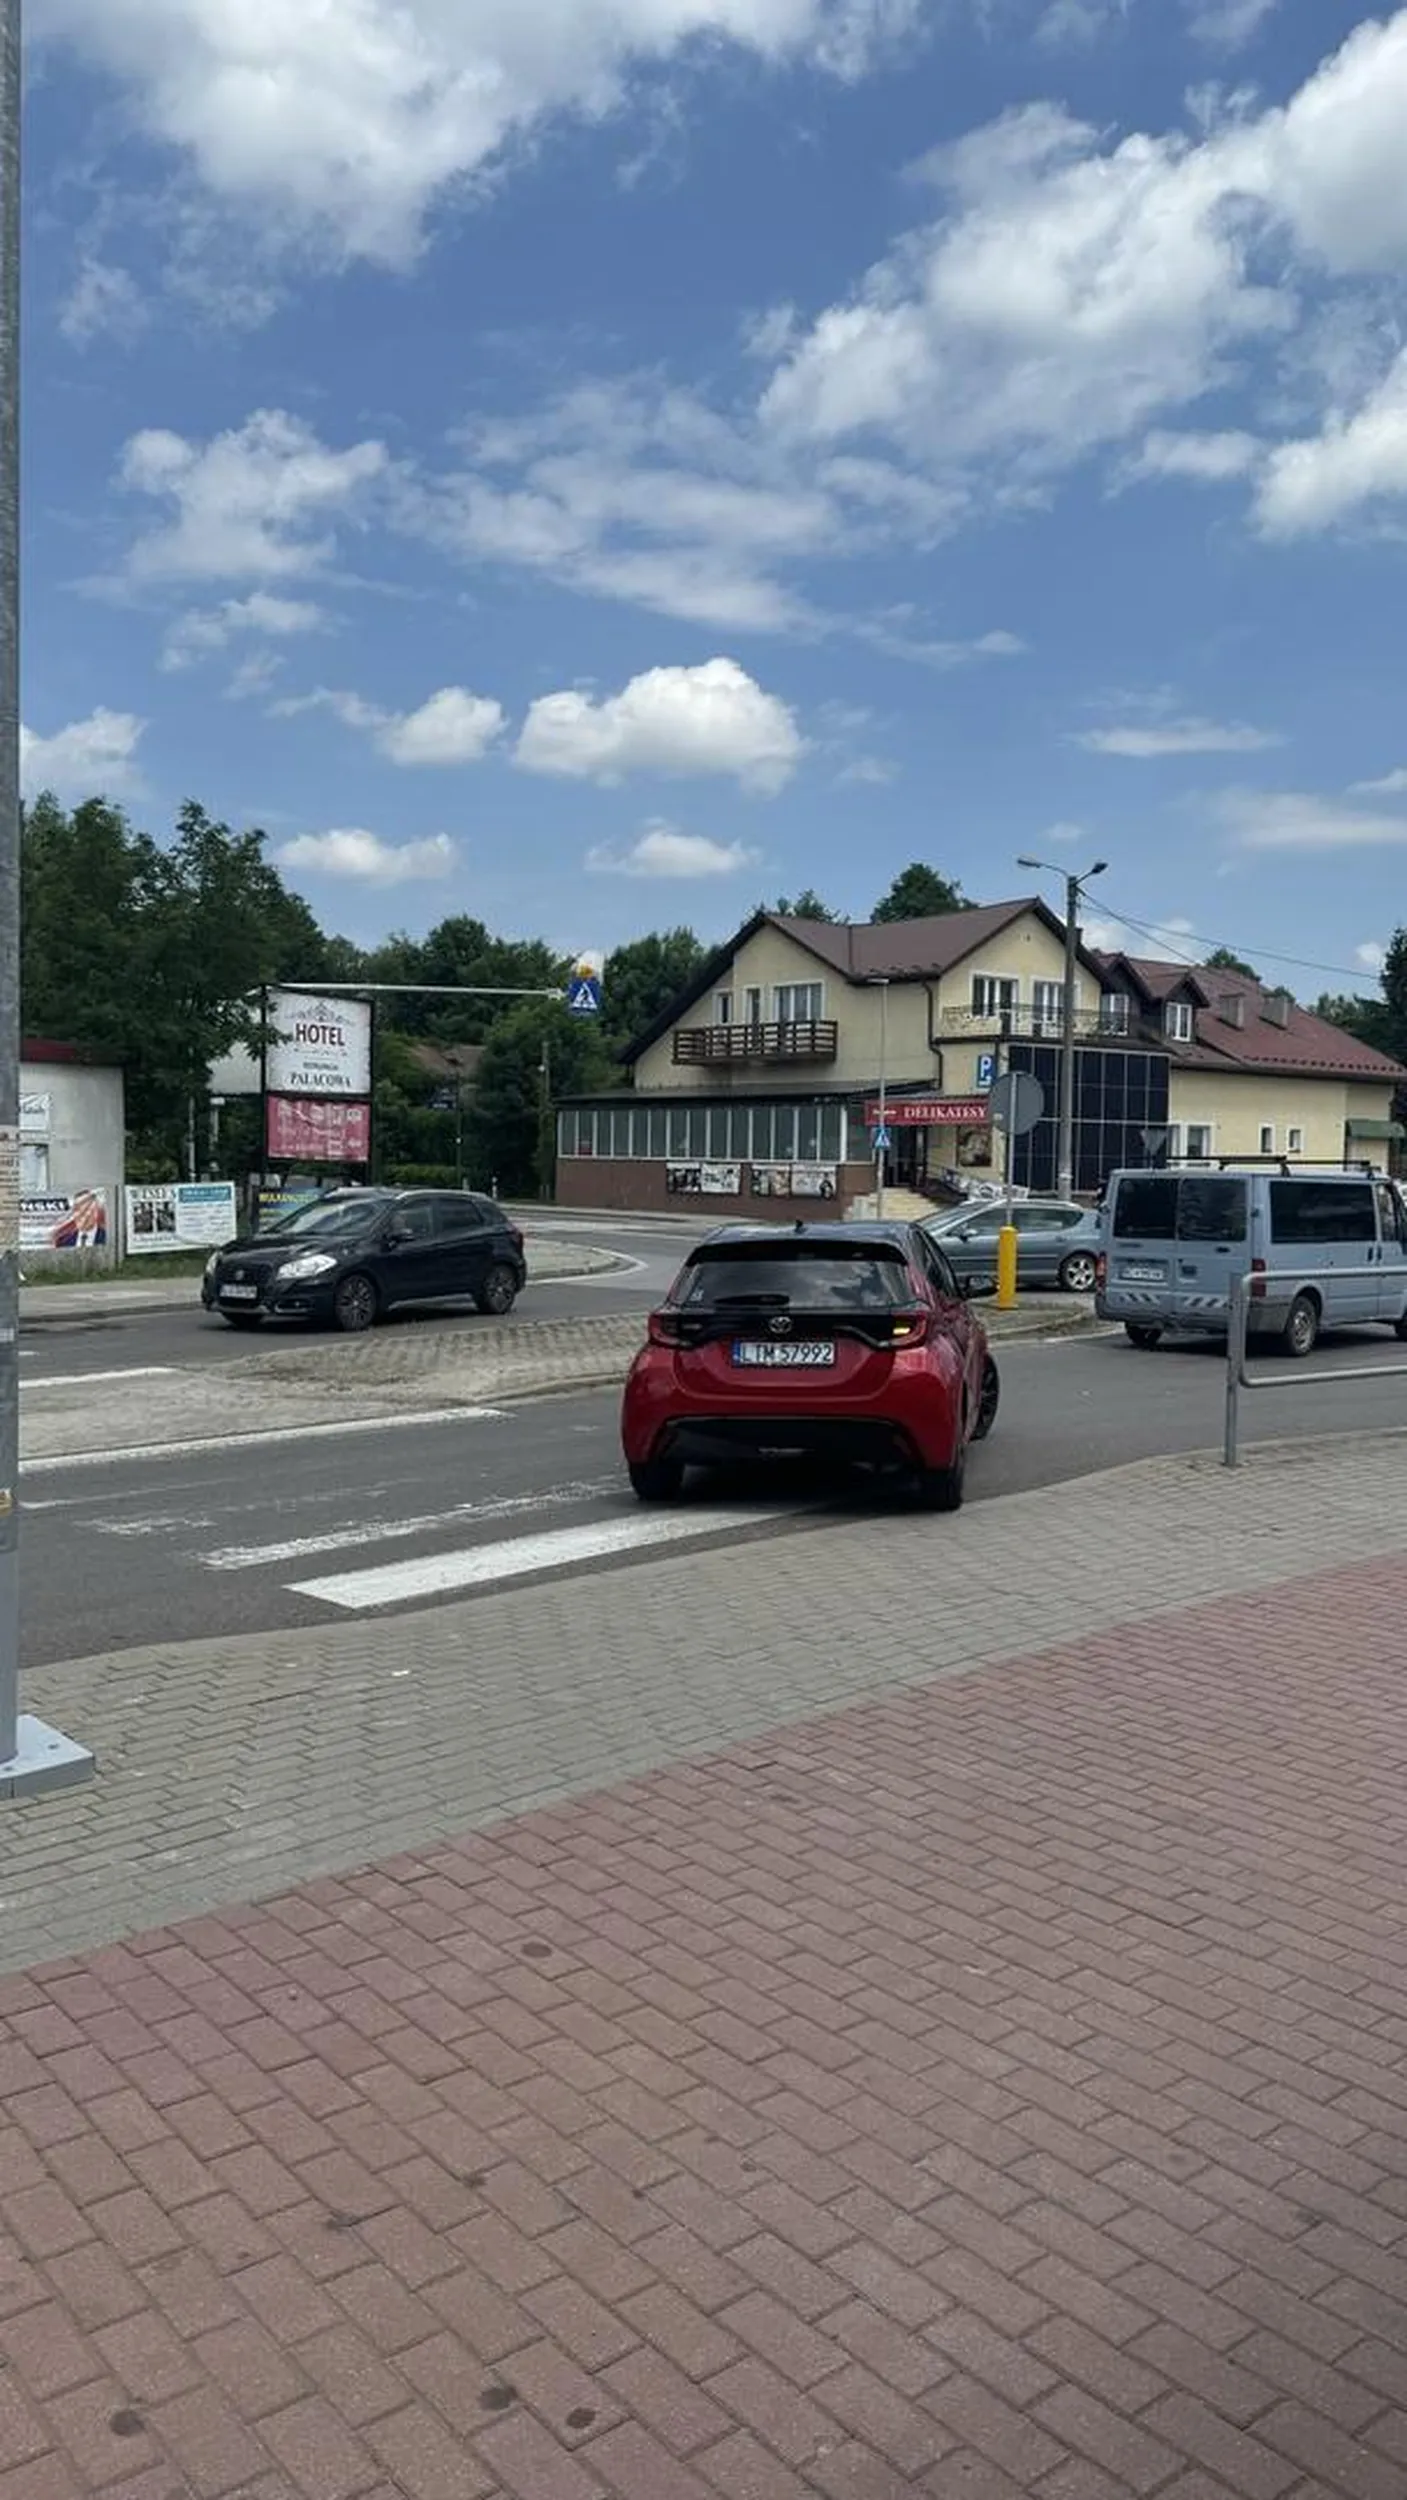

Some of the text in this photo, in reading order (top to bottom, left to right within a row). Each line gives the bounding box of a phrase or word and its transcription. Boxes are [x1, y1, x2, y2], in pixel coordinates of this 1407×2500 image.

[295, 1023, 345, 1046] HOTEL
[903, 1104, 987, 1120] DELIKATESY
[781, 1344, 832, 1362] 57992
